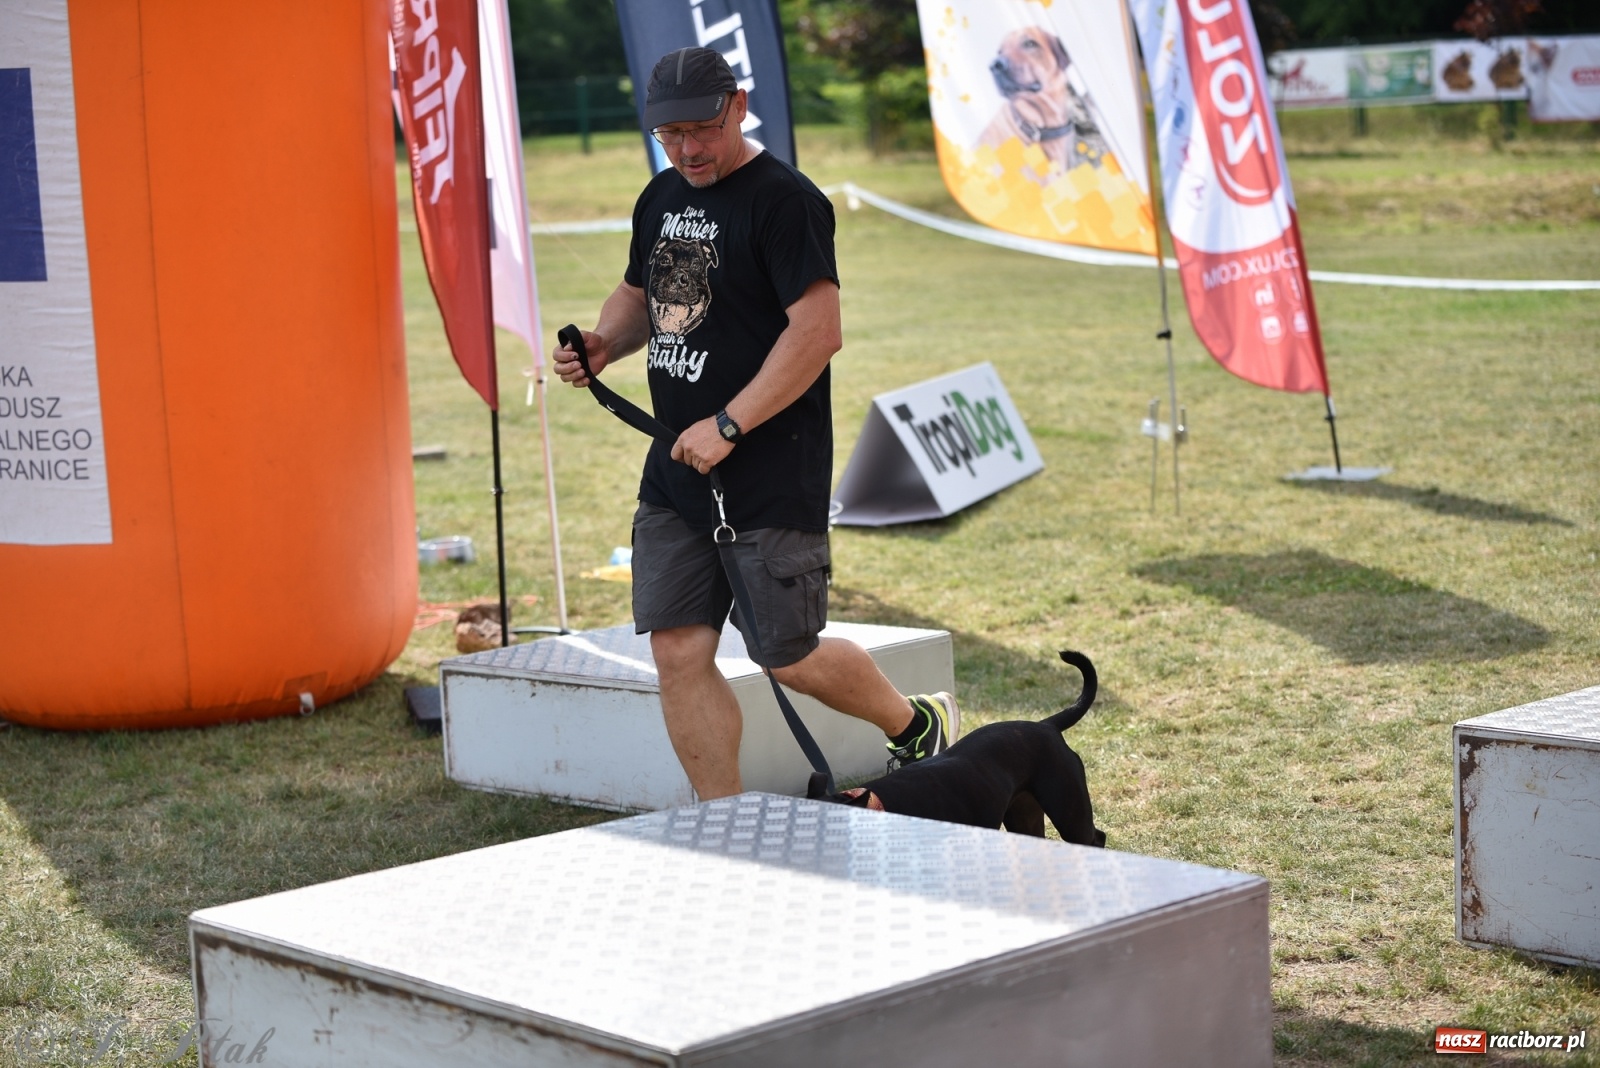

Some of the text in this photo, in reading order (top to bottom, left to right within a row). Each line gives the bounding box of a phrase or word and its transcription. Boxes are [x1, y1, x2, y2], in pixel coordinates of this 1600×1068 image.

[660, 212, 719, 240] Merrier
[682, 205, 705, 219] Life is
[657, 332, 686, 345] with a
[648, 336, 709, 383] Staffy
[892, 389, 1024, 478] TropiDog
